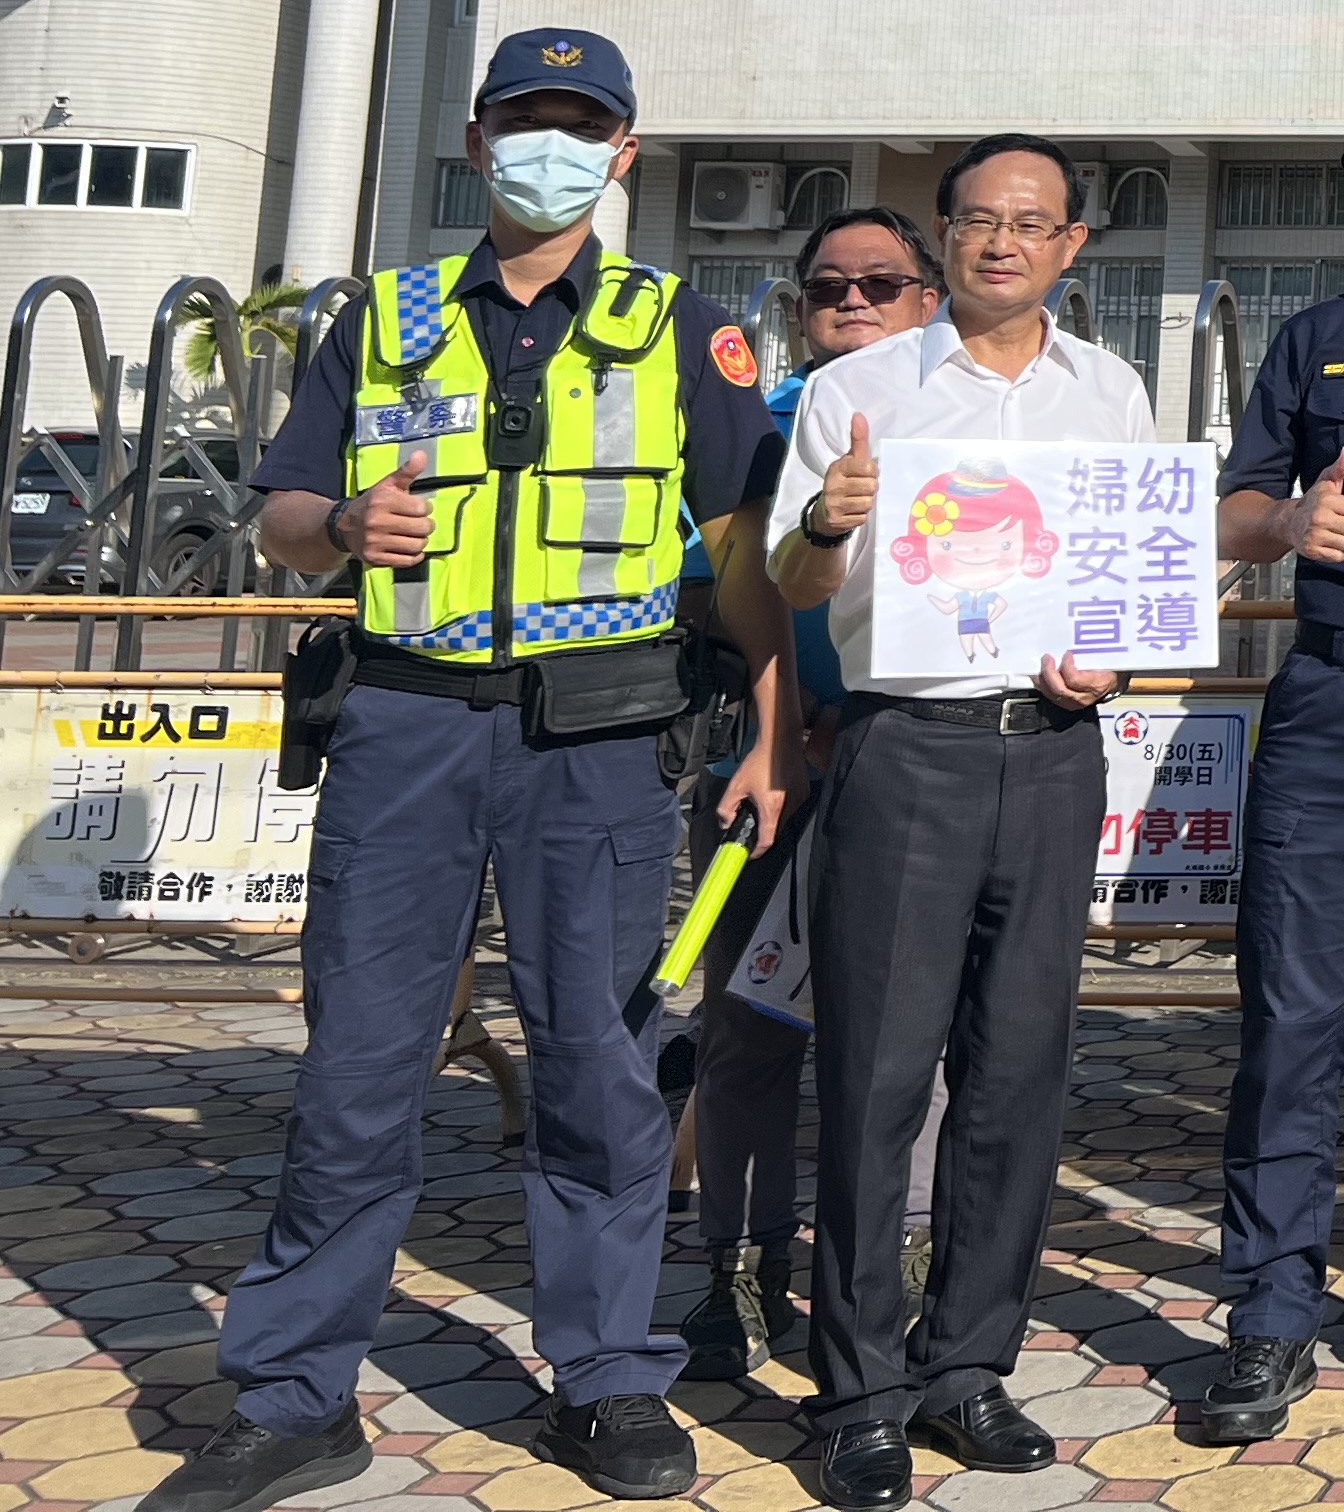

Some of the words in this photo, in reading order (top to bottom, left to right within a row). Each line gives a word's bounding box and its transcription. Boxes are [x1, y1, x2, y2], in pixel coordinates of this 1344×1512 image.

[1066, 457, 1196, 517] 婦幼
[1066, 525, 1198, 586] 安全
[1067, 592, 1199, 655] 宣導
[97, 701, 229, 743] 出入口
[1143, 742, 1223, 764] 8/30(五)
[1154, 766, 1213, 785] 開學日
